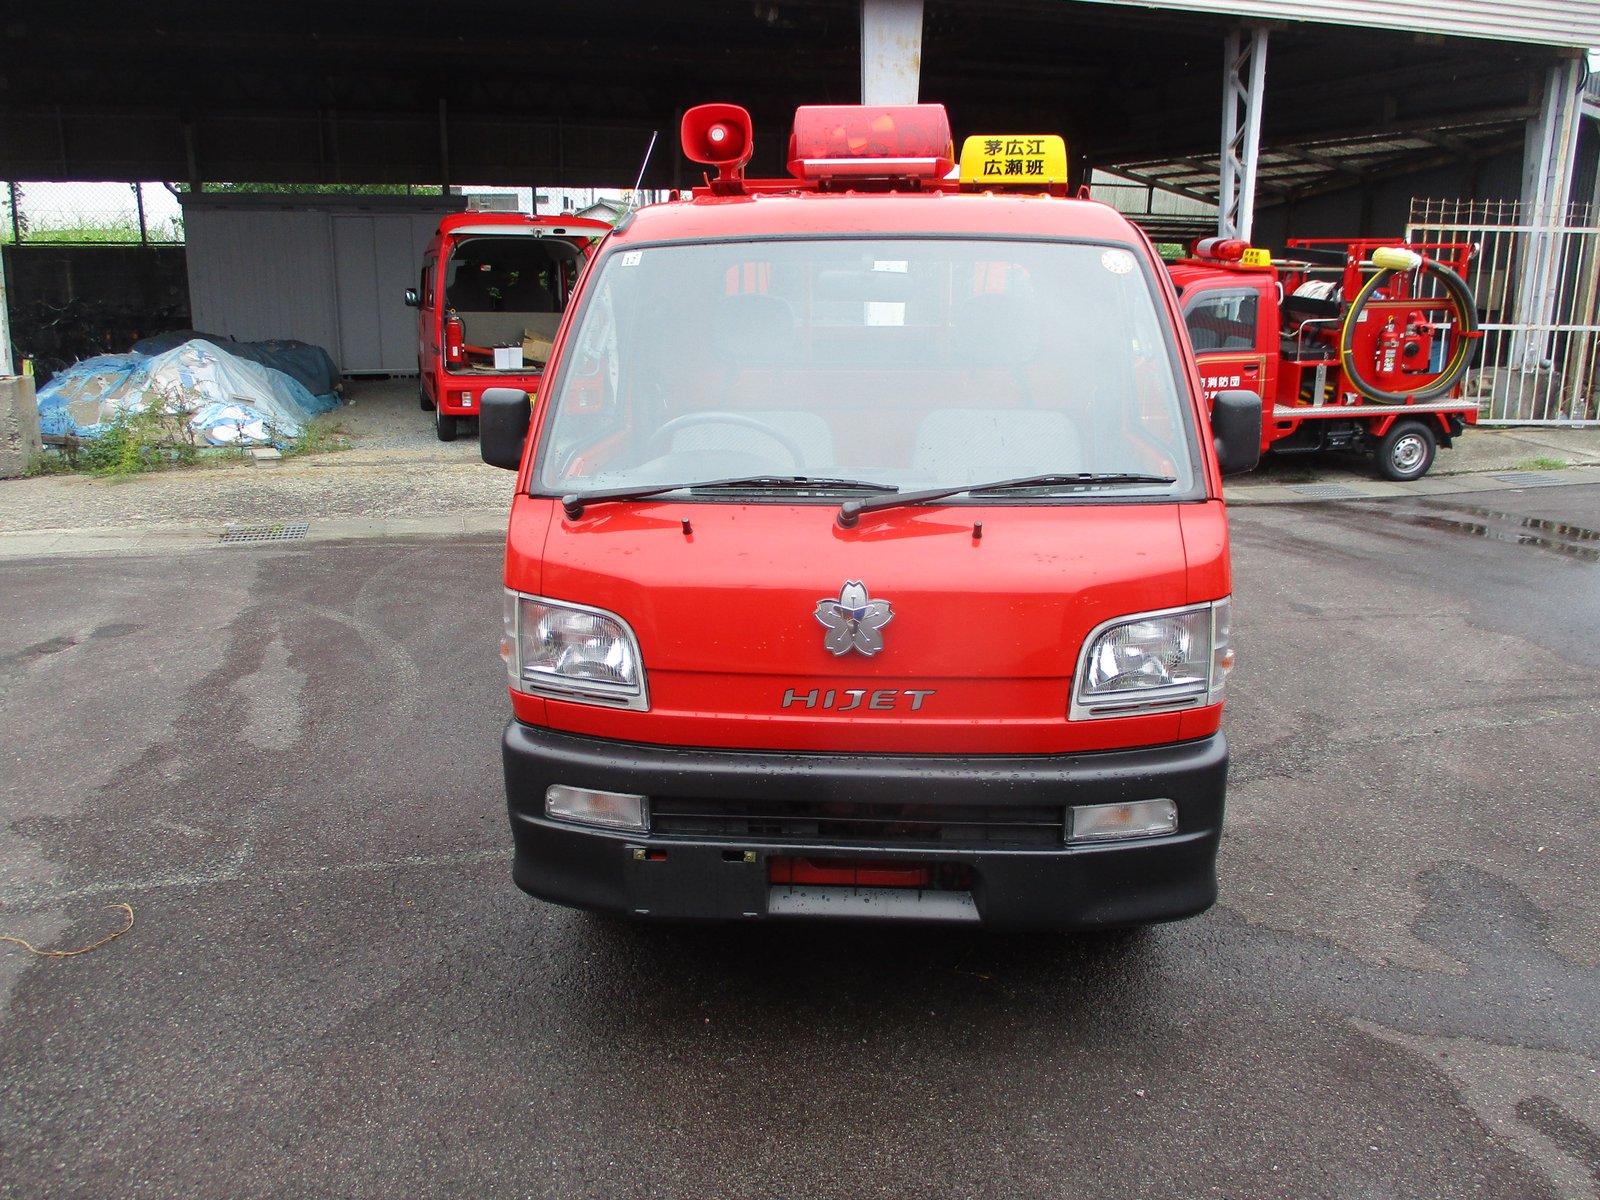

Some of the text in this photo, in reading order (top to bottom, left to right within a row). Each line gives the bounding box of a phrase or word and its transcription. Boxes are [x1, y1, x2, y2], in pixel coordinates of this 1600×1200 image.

[984, 139, 1045, 156] 茅広江
[983, 159, 1044, 176] 広瀬班
[781, 689, 938, 711] HIJET
